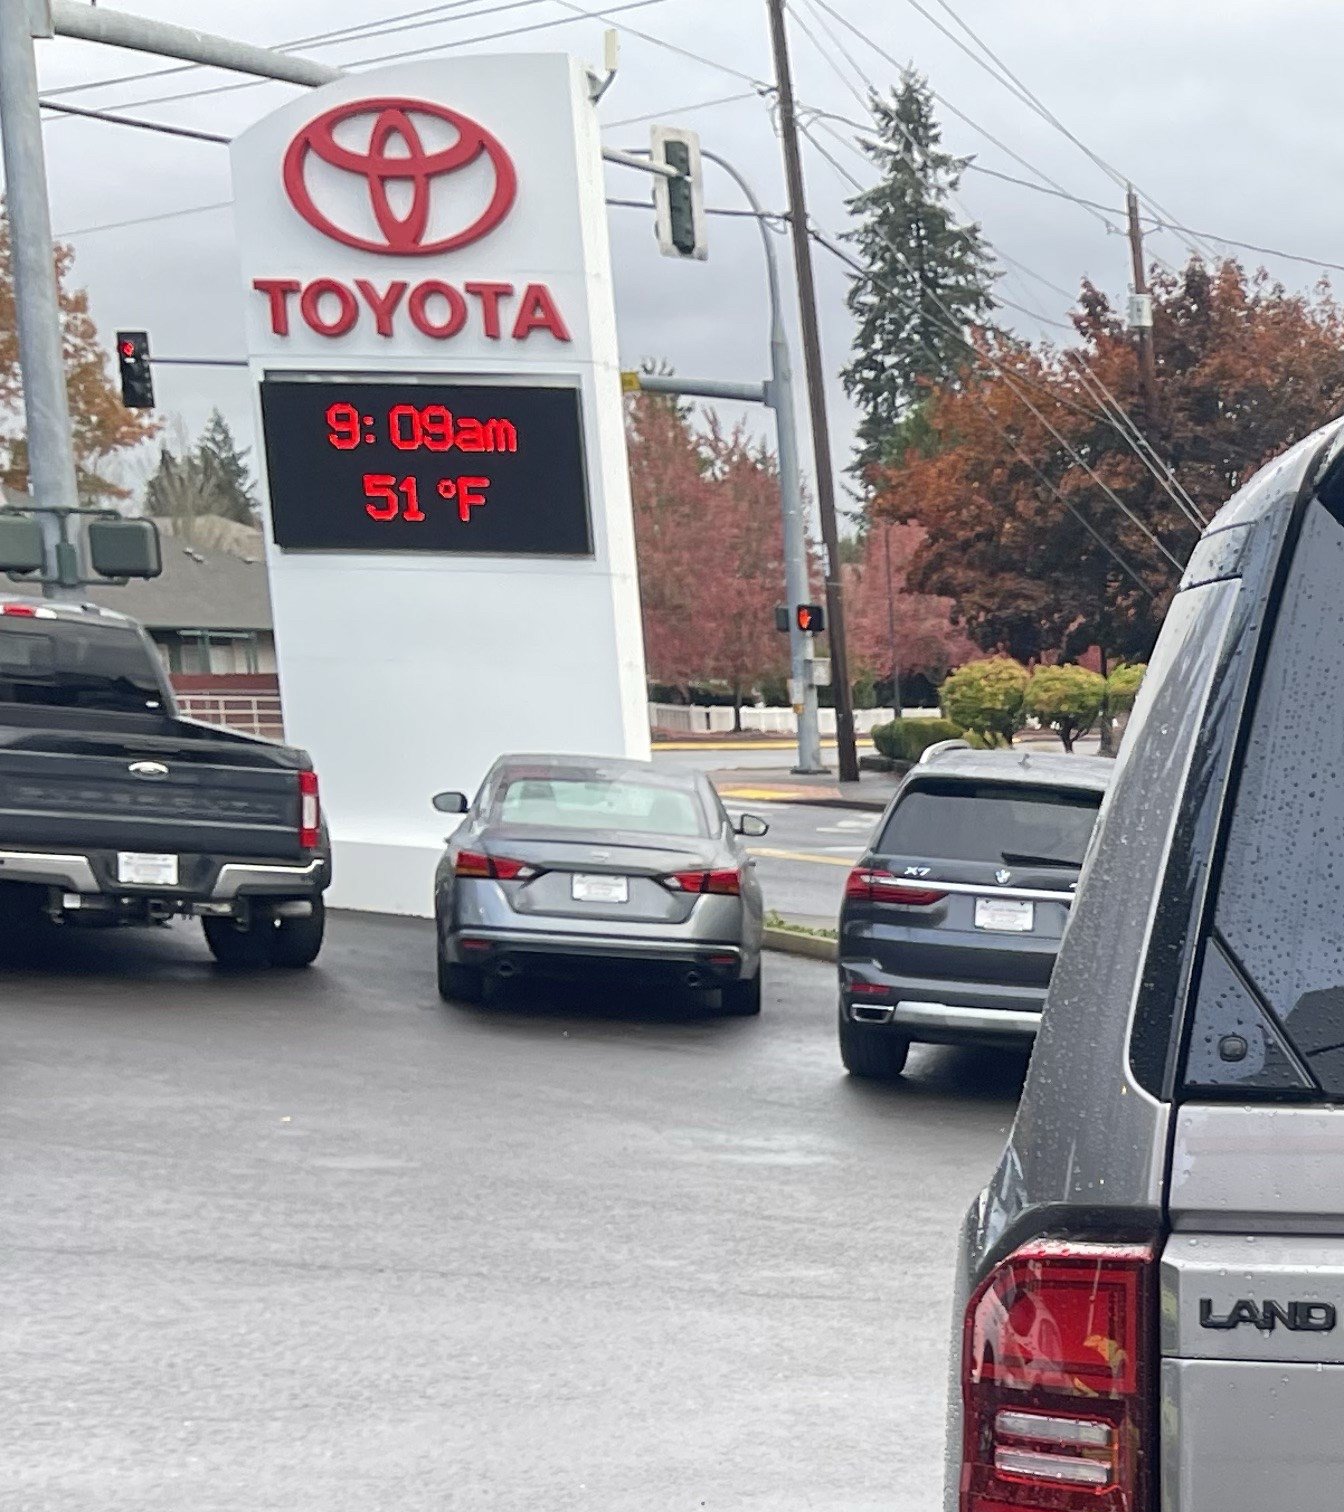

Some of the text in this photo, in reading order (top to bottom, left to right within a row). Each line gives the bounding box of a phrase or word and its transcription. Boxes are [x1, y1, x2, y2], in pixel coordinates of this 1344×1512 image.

[253, 277, 571, 342] TOYOTA
[362, 474, 426, 522] 51
[904, 866, 931, 876] X7
[1199, 1298, 1337, 1332] LAND
